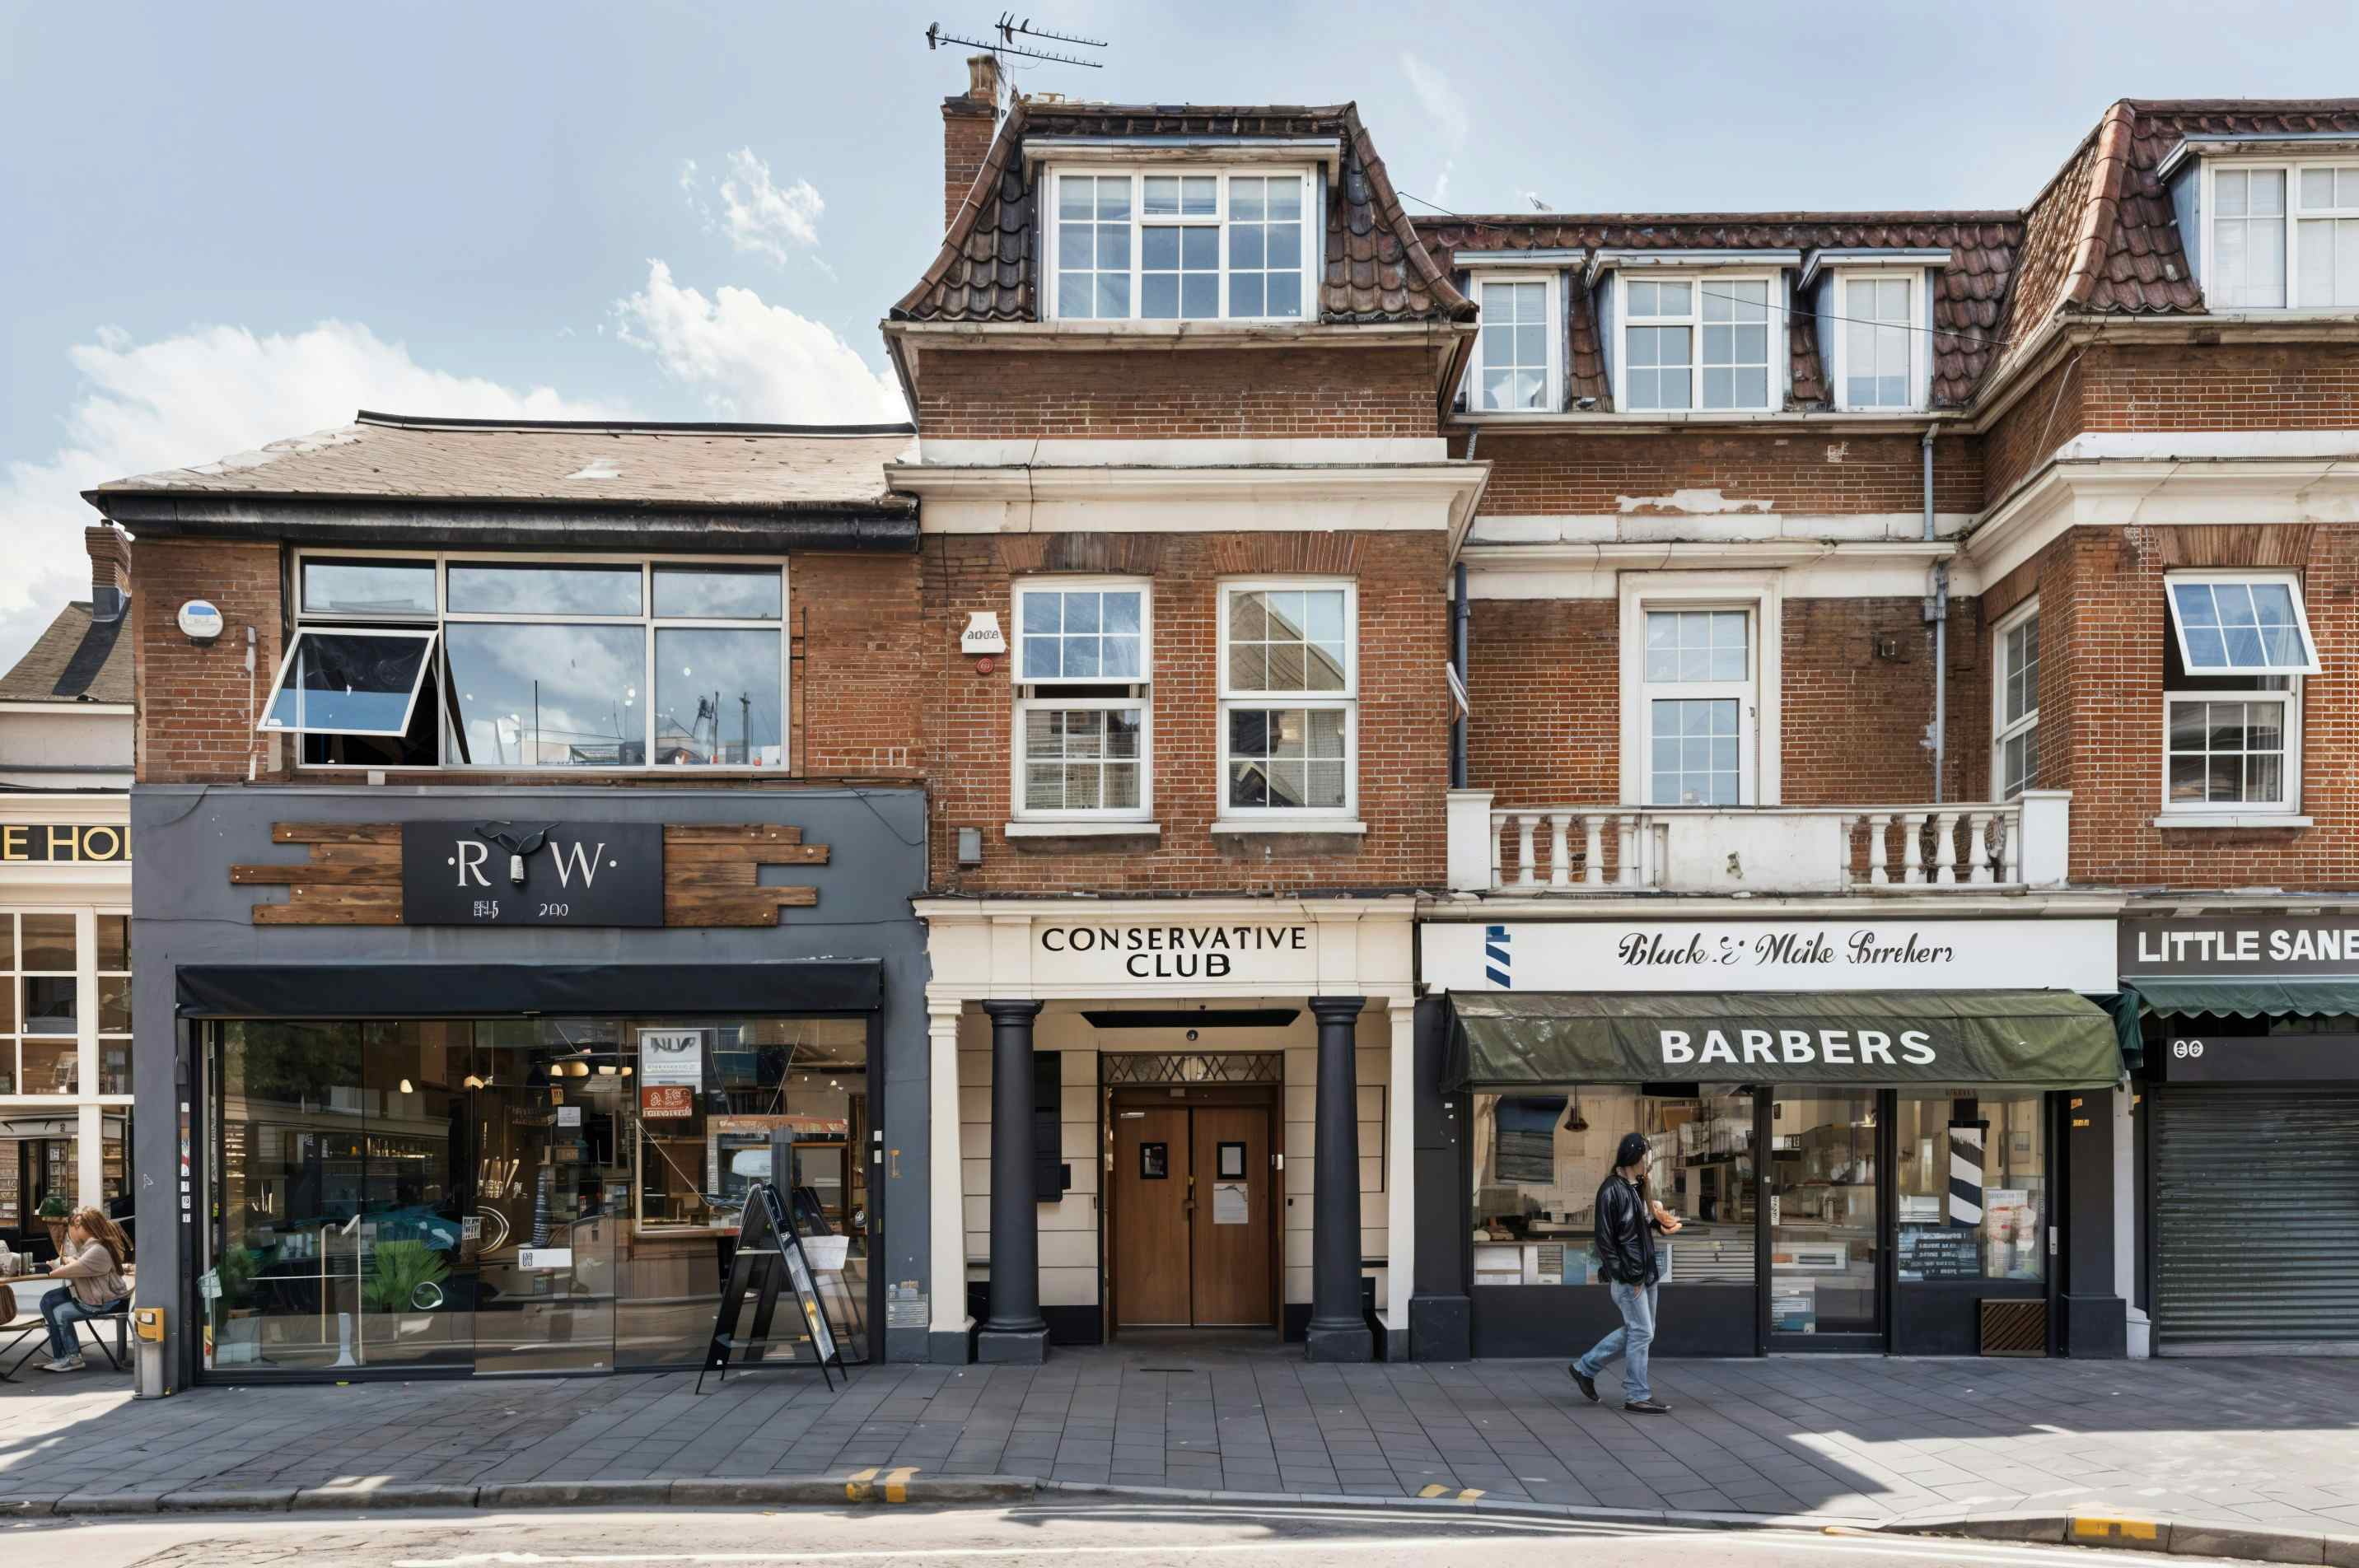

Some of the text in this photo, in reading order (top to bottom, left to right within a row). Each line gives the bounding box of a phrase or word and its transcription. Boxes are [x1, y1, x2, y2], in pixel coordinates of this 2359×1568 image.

[1041, 926, 1307, 951] CONSERVATIVE
[2138, 931, 2259, 962] LITTLE
[1126, 953, 1231, 978] CLUB
[1660, 1029, 1936, 1064] BARBERS
